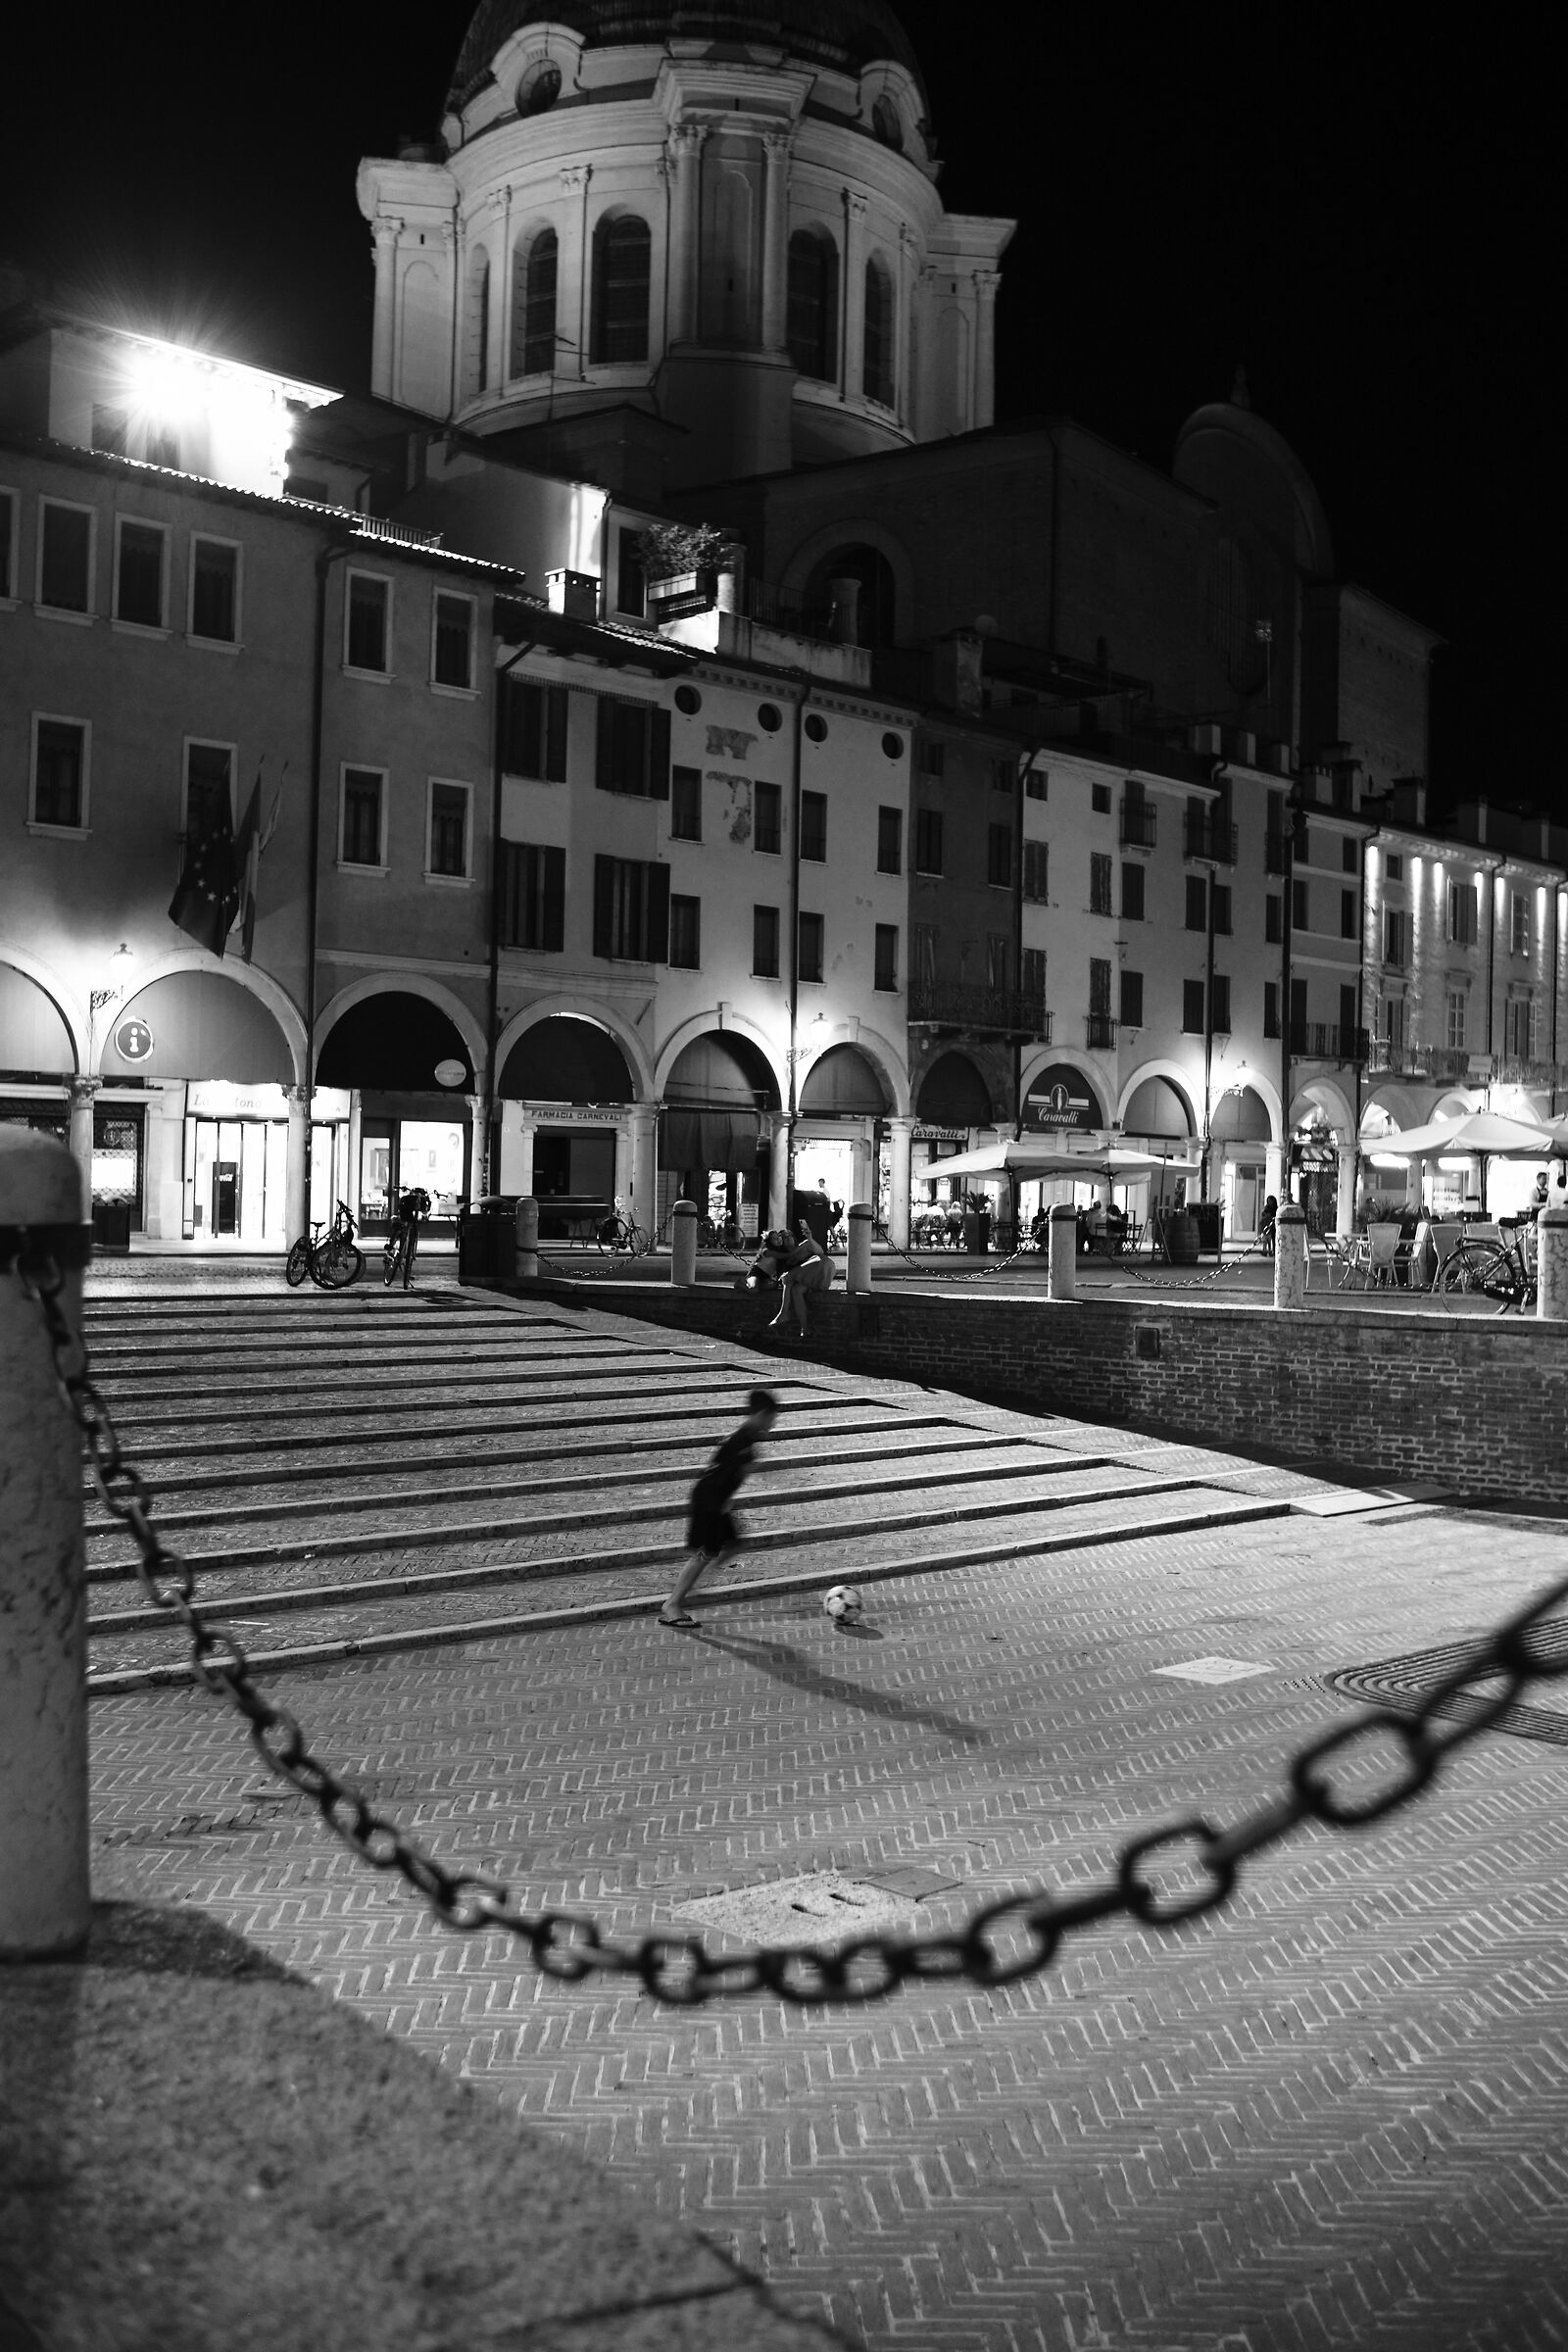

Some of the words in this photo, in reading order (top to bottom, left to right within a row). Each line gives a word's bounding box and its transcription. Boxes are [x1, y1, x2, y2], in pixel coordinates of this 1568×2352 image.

[531, 1110, 573, 1119] FARMACIA
[577, 1112, 622, 1121] CARNEVALI
[1037, 1106, 1079, 1124] Caravalli
